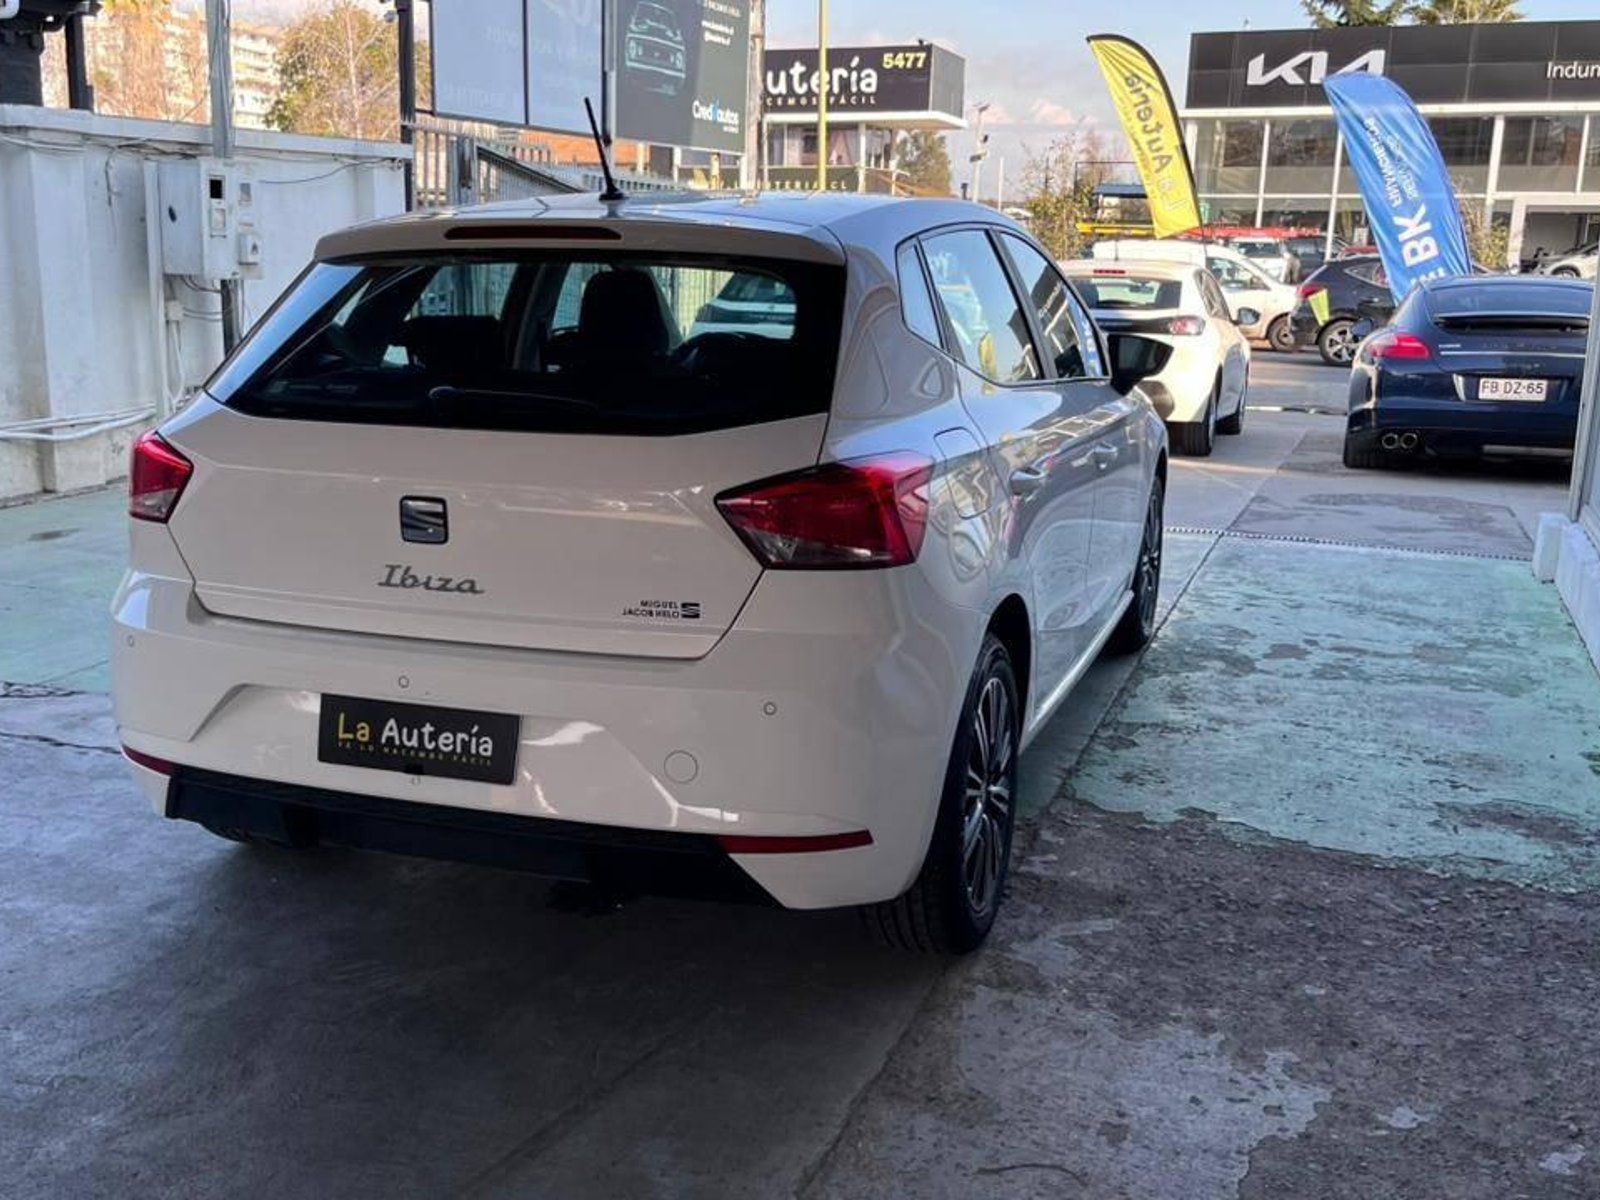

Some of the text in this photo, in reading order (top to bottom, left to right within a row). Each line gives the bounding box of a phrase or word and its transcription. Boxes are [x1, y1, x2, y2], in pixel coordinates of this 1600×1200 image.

[765, 55, 879, 95] utería
[882, 52, 927, 69] 5477
[1246, 49, 1386, 86] KIA
[765, 96, 818, 107] CEMOS
[377, 563, 486, 595] Ibiza
[640, 600, 679, 609] MIGUEL
[338, 711, 494, 758] La Autería
